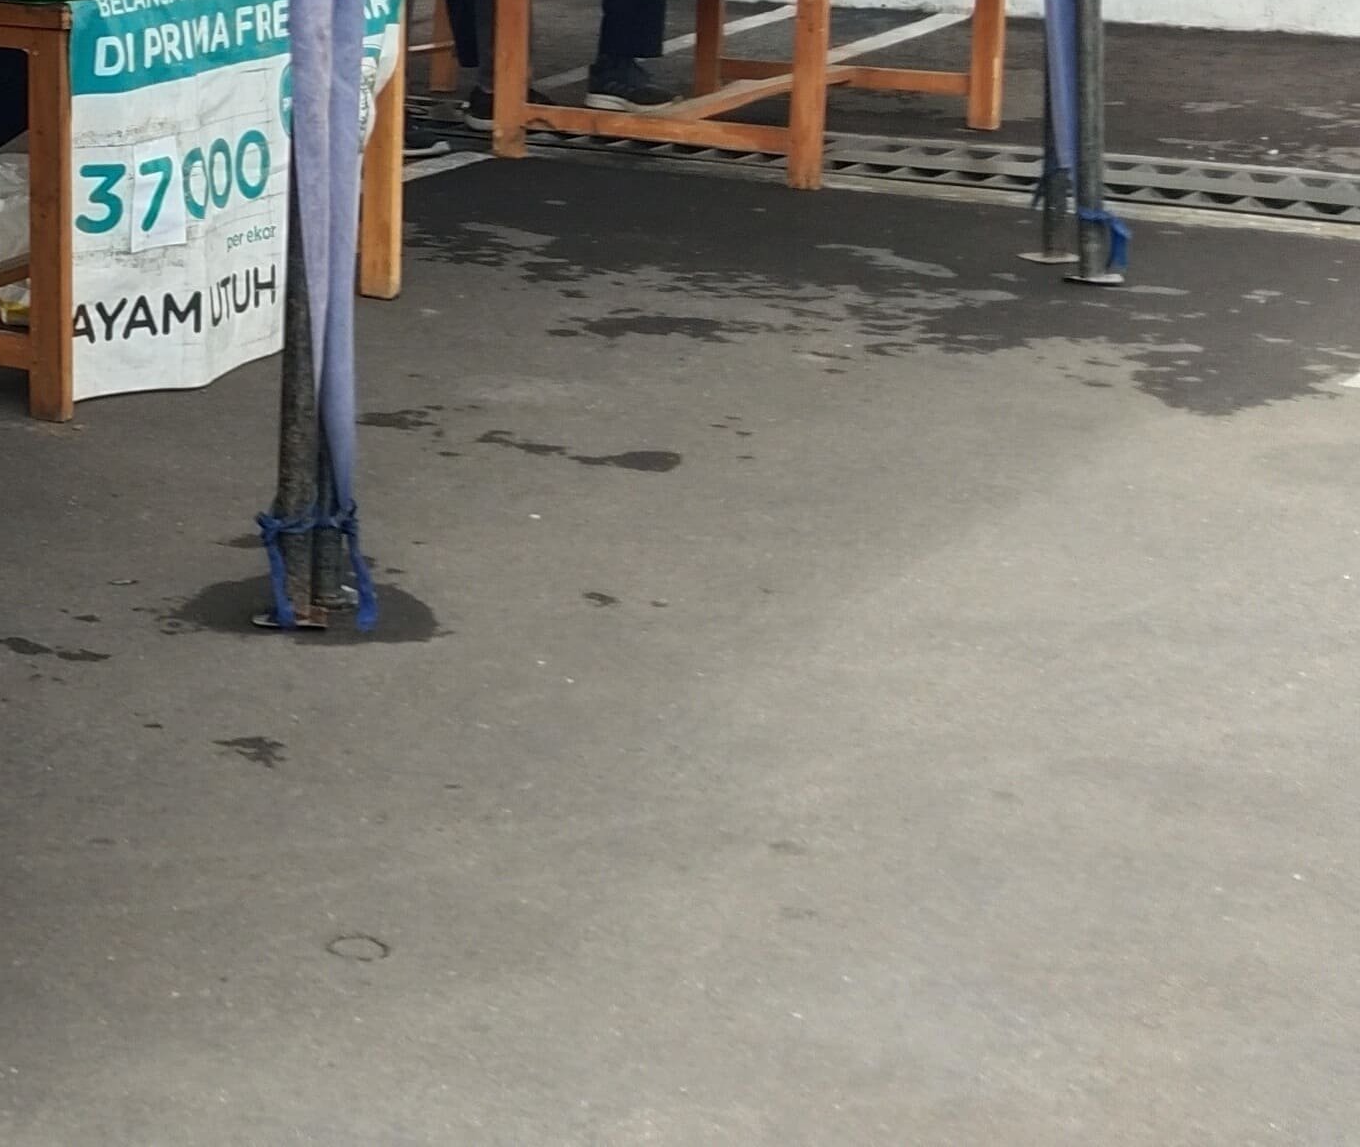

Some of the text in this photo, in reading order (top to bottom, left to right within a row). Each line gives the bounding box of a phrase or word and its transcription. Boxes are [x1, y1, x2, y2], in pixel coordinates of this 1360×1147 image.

[94, 32, 136, 77] DI
[226, 232, 244, 253] per
[72, 263, 277, 344] AYAM UTUH
